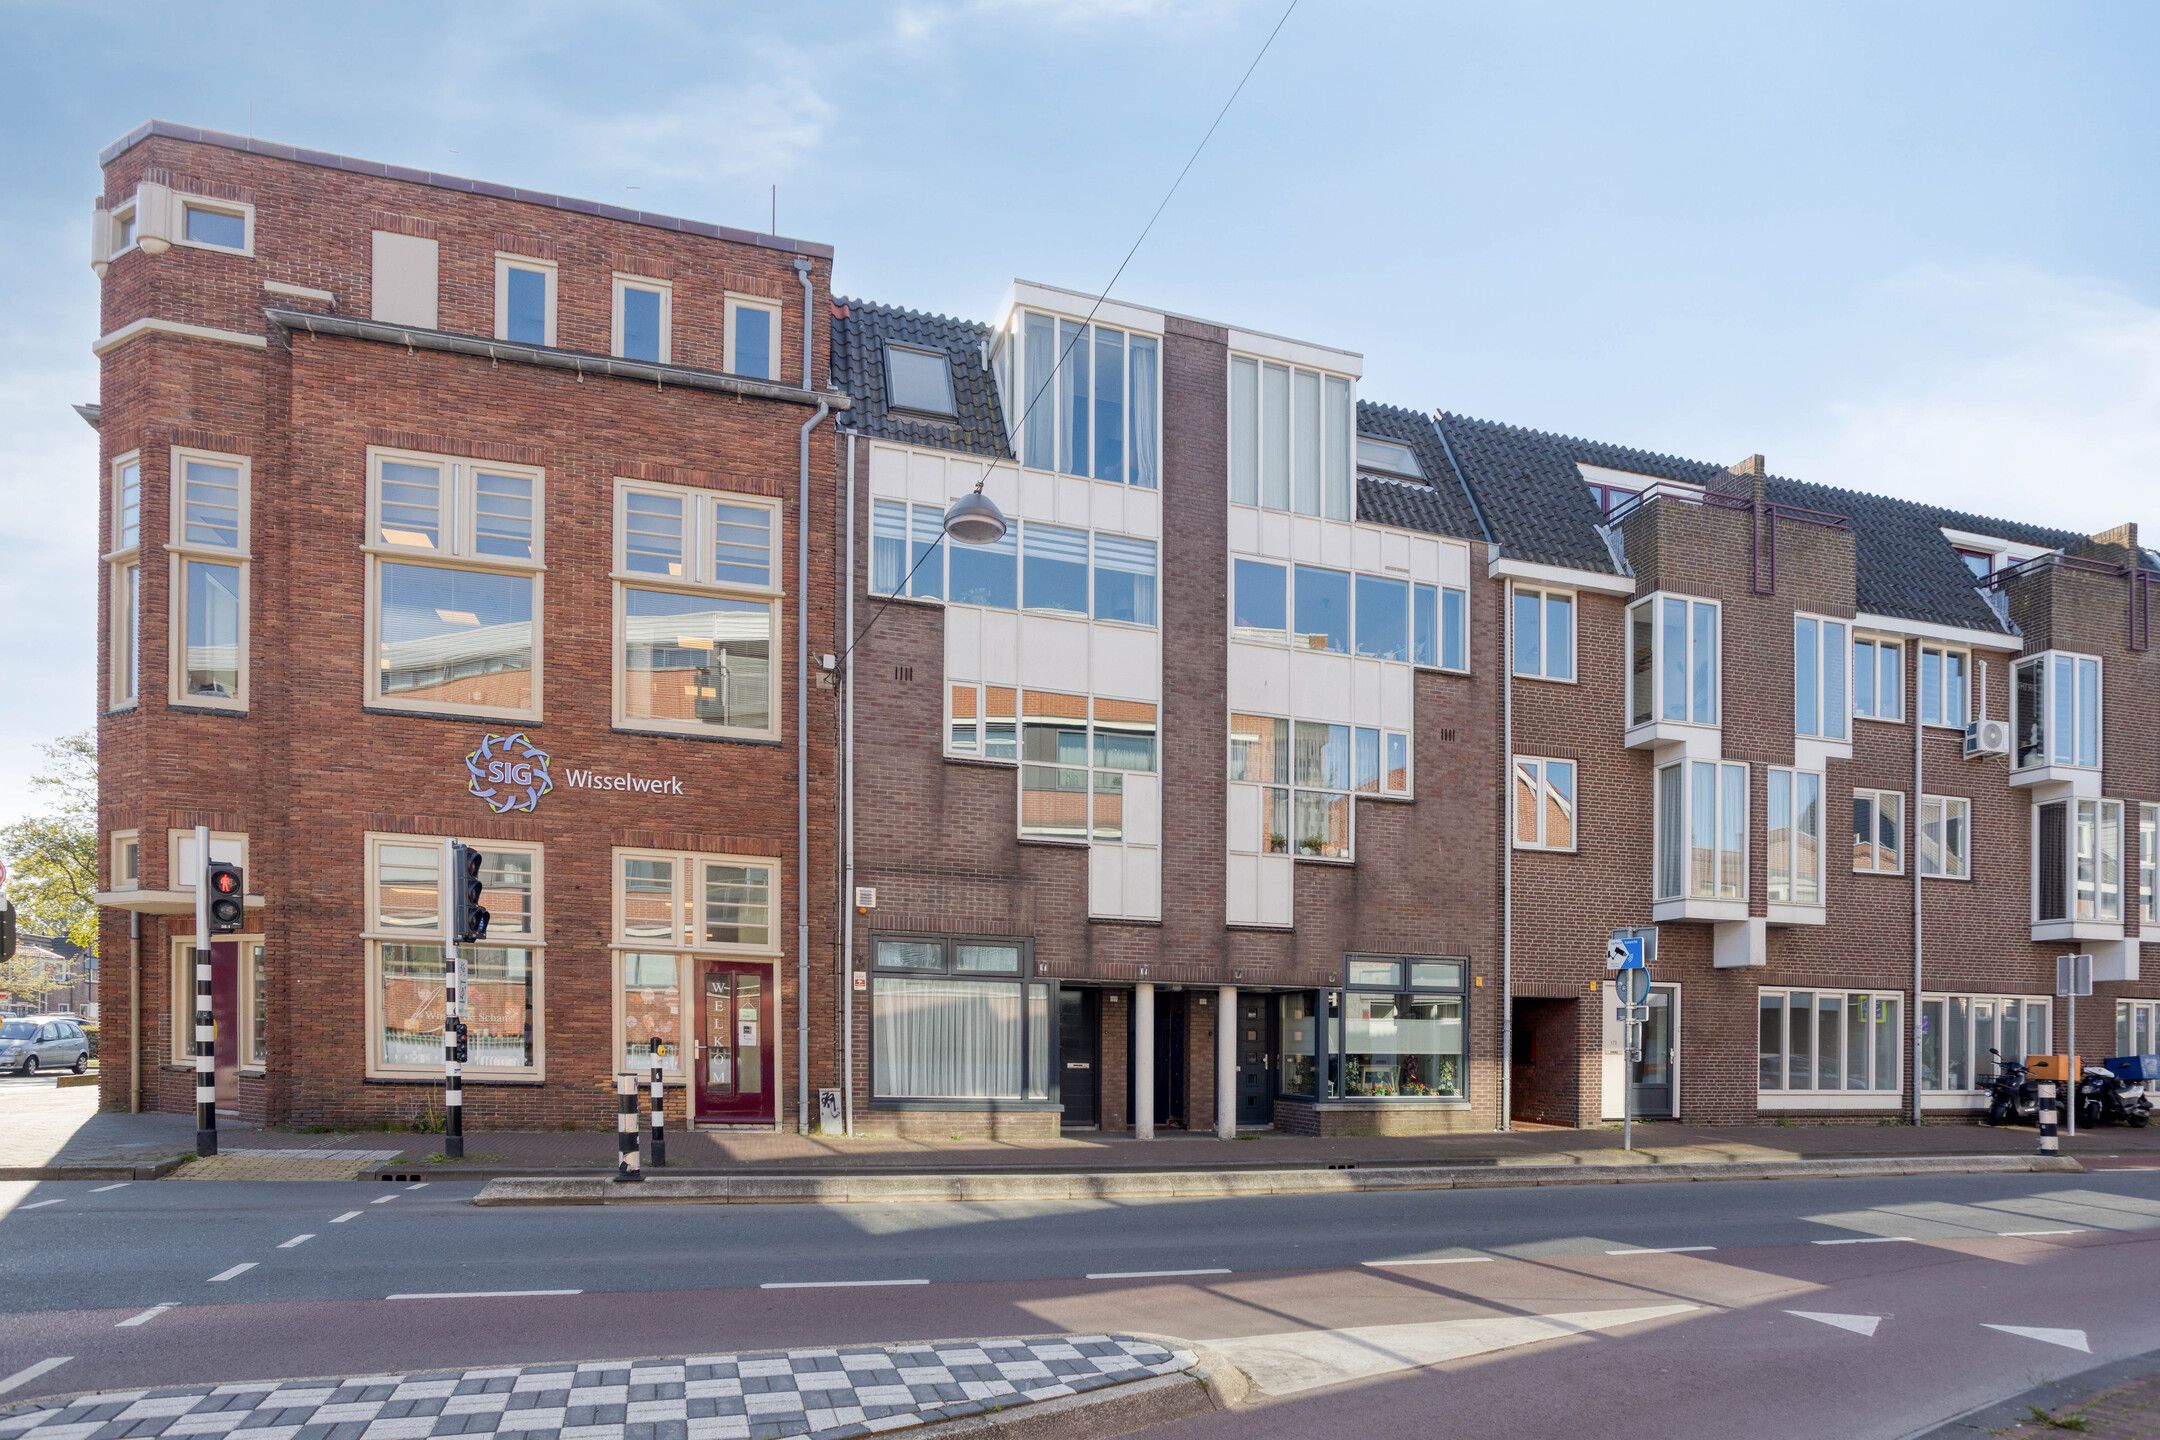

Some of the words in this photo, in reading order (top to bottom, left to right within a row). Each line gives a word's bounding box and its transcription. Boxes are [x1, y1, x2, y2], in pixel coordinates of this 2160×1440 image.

[489, 761, 532, 785] SIG
[566, 768, 684, 795] Wisselwerk
[712, 982, 725, 1083] WELKOM
